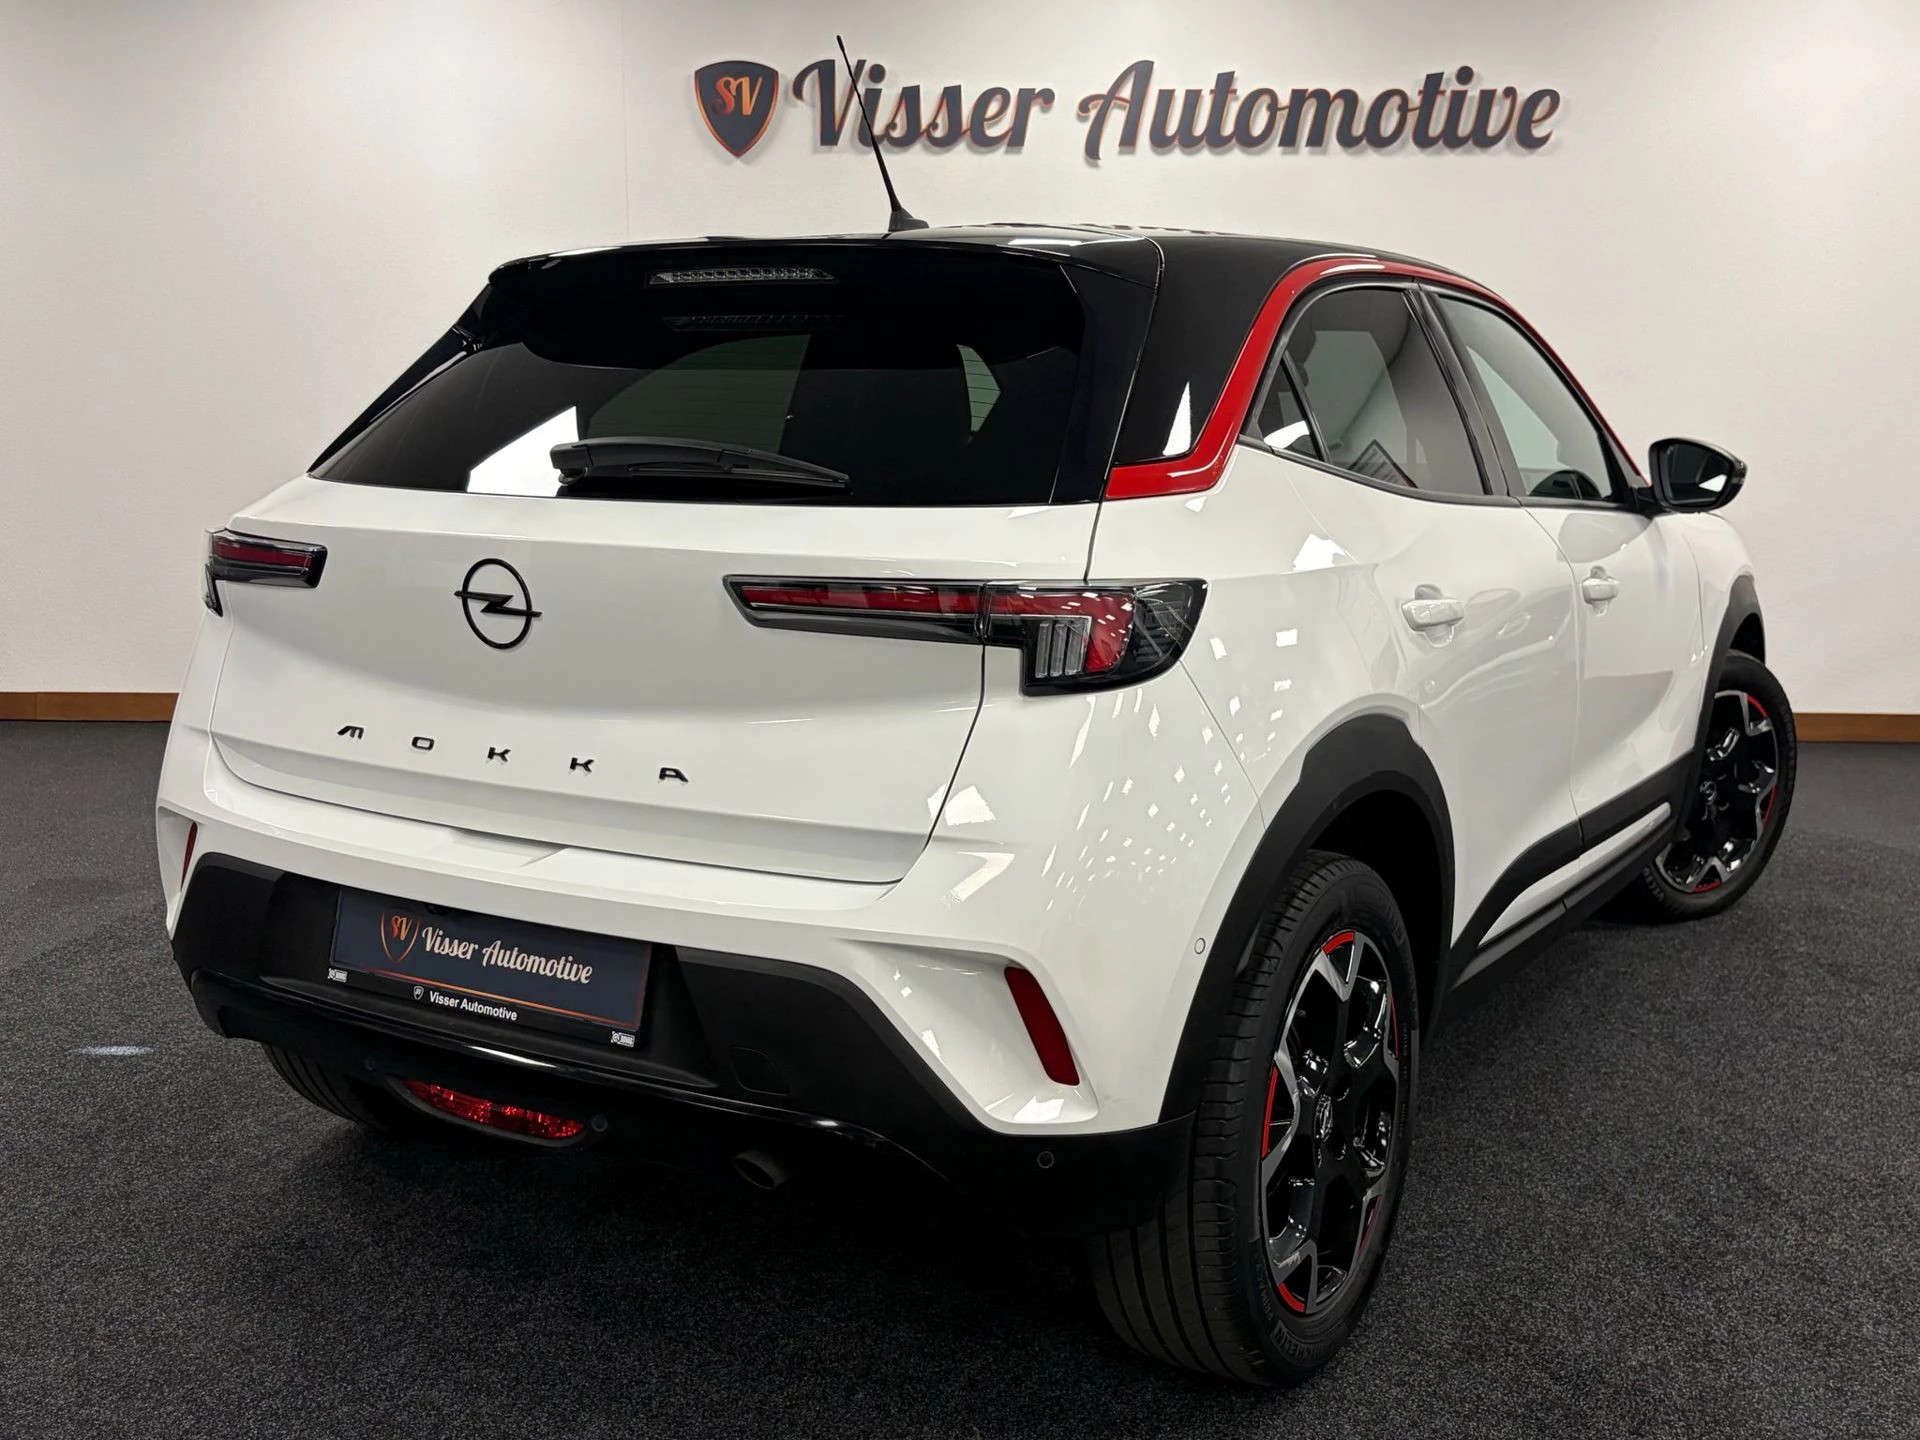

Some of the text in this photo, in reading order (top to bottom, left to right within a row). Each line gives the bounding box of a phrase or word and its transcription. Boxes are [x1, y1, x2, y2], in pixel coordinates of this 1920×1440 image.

[711, 76, 762, 116] SV
[793, 59, 1561, 160] Visser Automotive
[337, 725, 688, 783] MOKKA
[422, 926, 593, 984] Visser Automotive
[429, 991, 518, 1021] Visser Automotive
